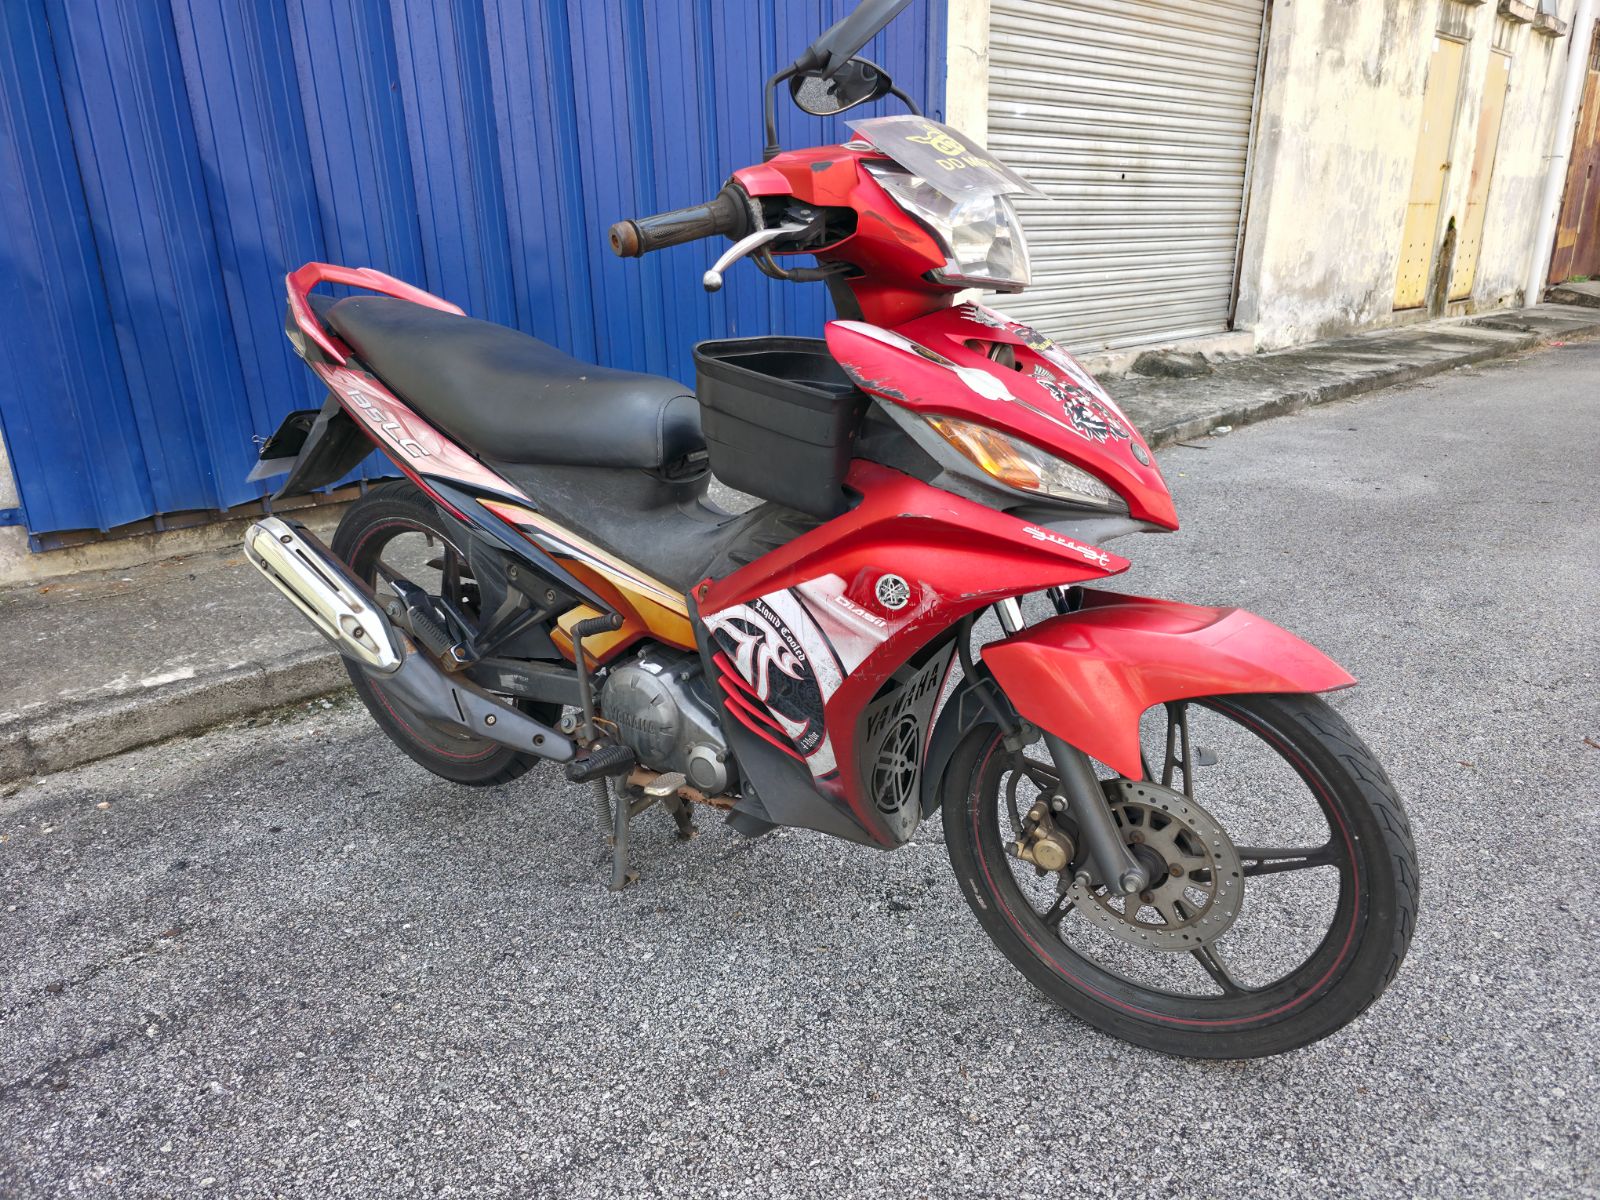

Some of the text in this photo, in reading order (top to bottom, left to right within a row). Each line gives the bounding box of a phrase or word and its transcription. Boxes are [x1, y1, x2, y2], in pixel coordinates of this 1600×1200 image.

[936, 158, 965, 171] DD
[755, 598, 806, 661] Liquid Cooled
[866, 662, 940, 743] YAMAHA
